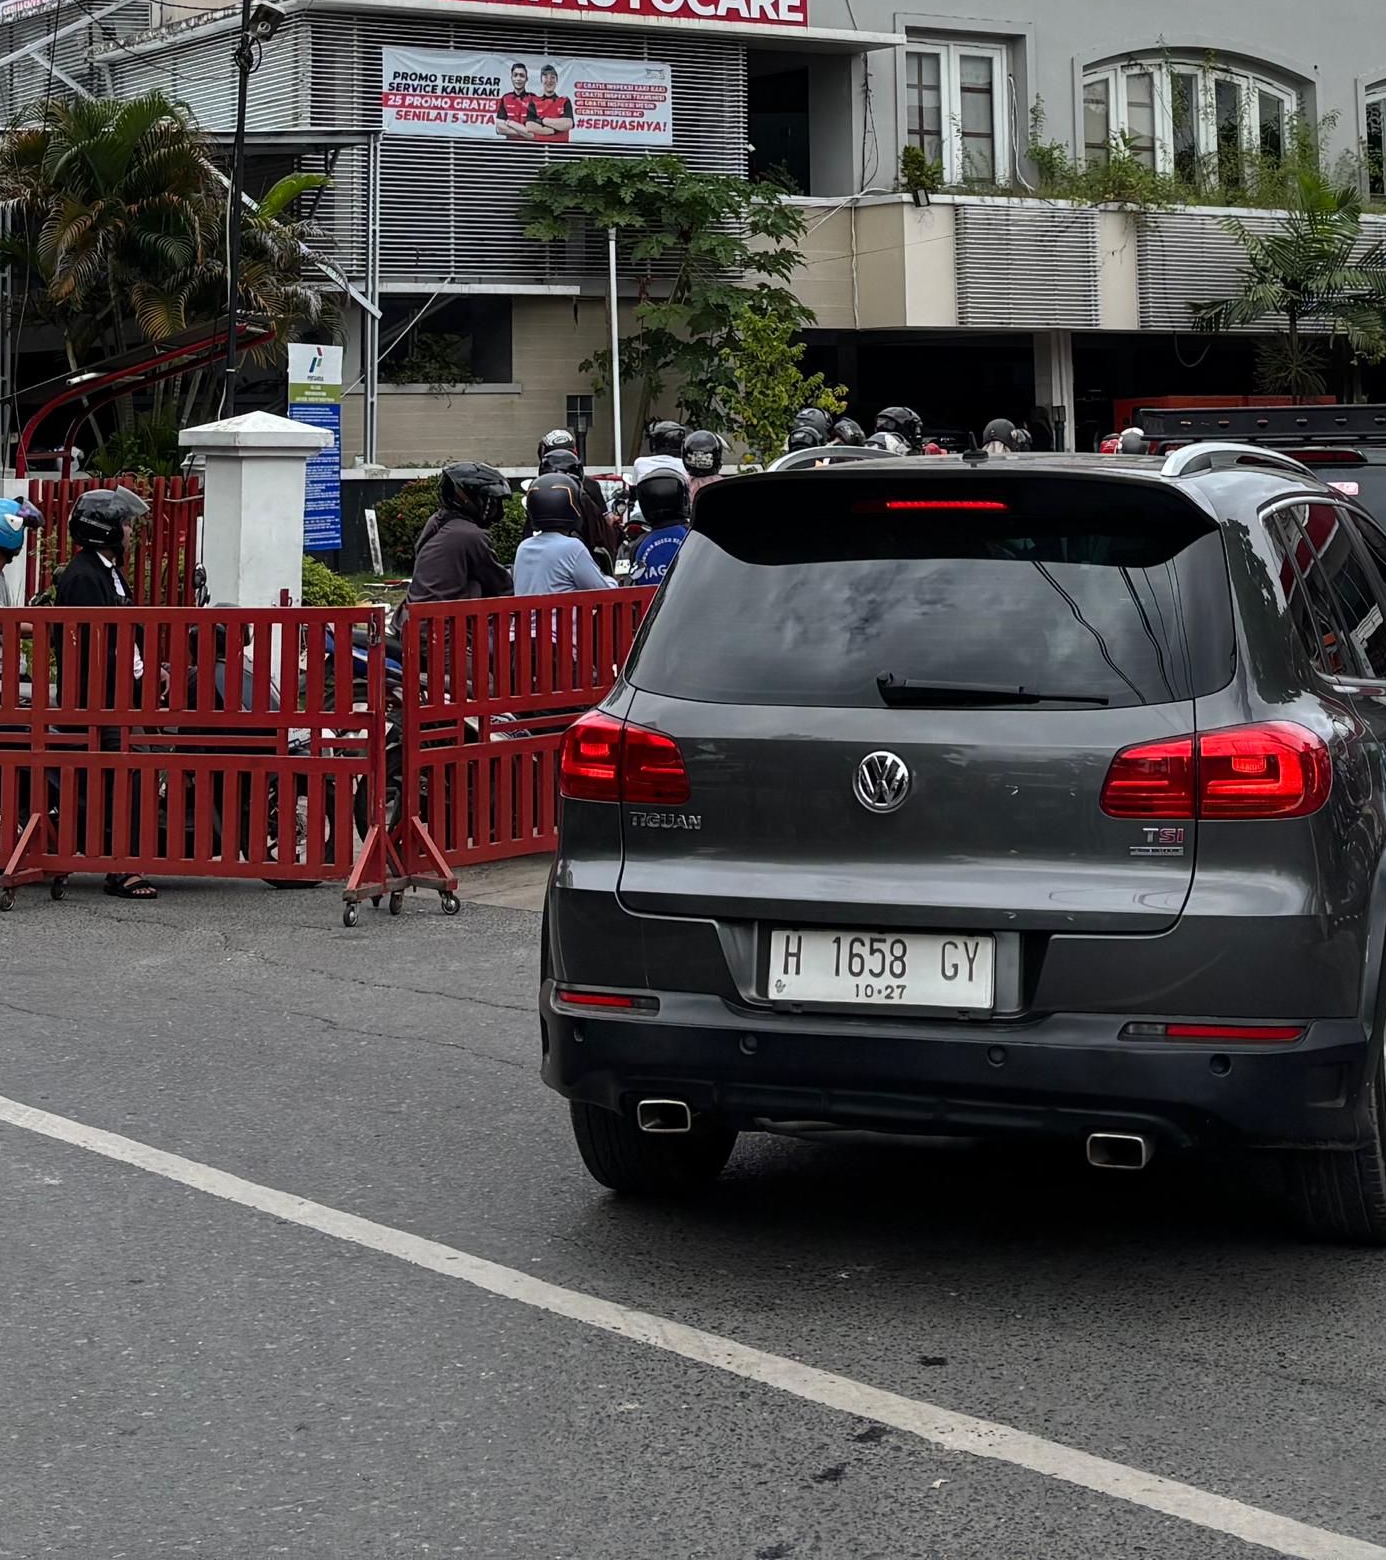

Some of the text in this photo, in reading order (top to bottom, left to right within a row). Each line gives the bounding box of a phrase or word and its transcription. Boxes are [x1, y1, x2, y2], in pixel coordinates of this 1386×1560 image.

[393, 71, 501, 87] PROMO TERBESAR
[388, 82, 500, 97] SERVICE KAKI KAKI
[388, 95, 497, 110] 25 PROMO GRATIS
[395, 109, 496, 125] SENILAI 5 JUTA
[576, 118, 667, 132] #SEPUASNYA!
[629, 811, 701, 830] TIGUAN
[1142, 827, 1184, 843] TSI
[782, 934, 980, 982] H 1658 GY
